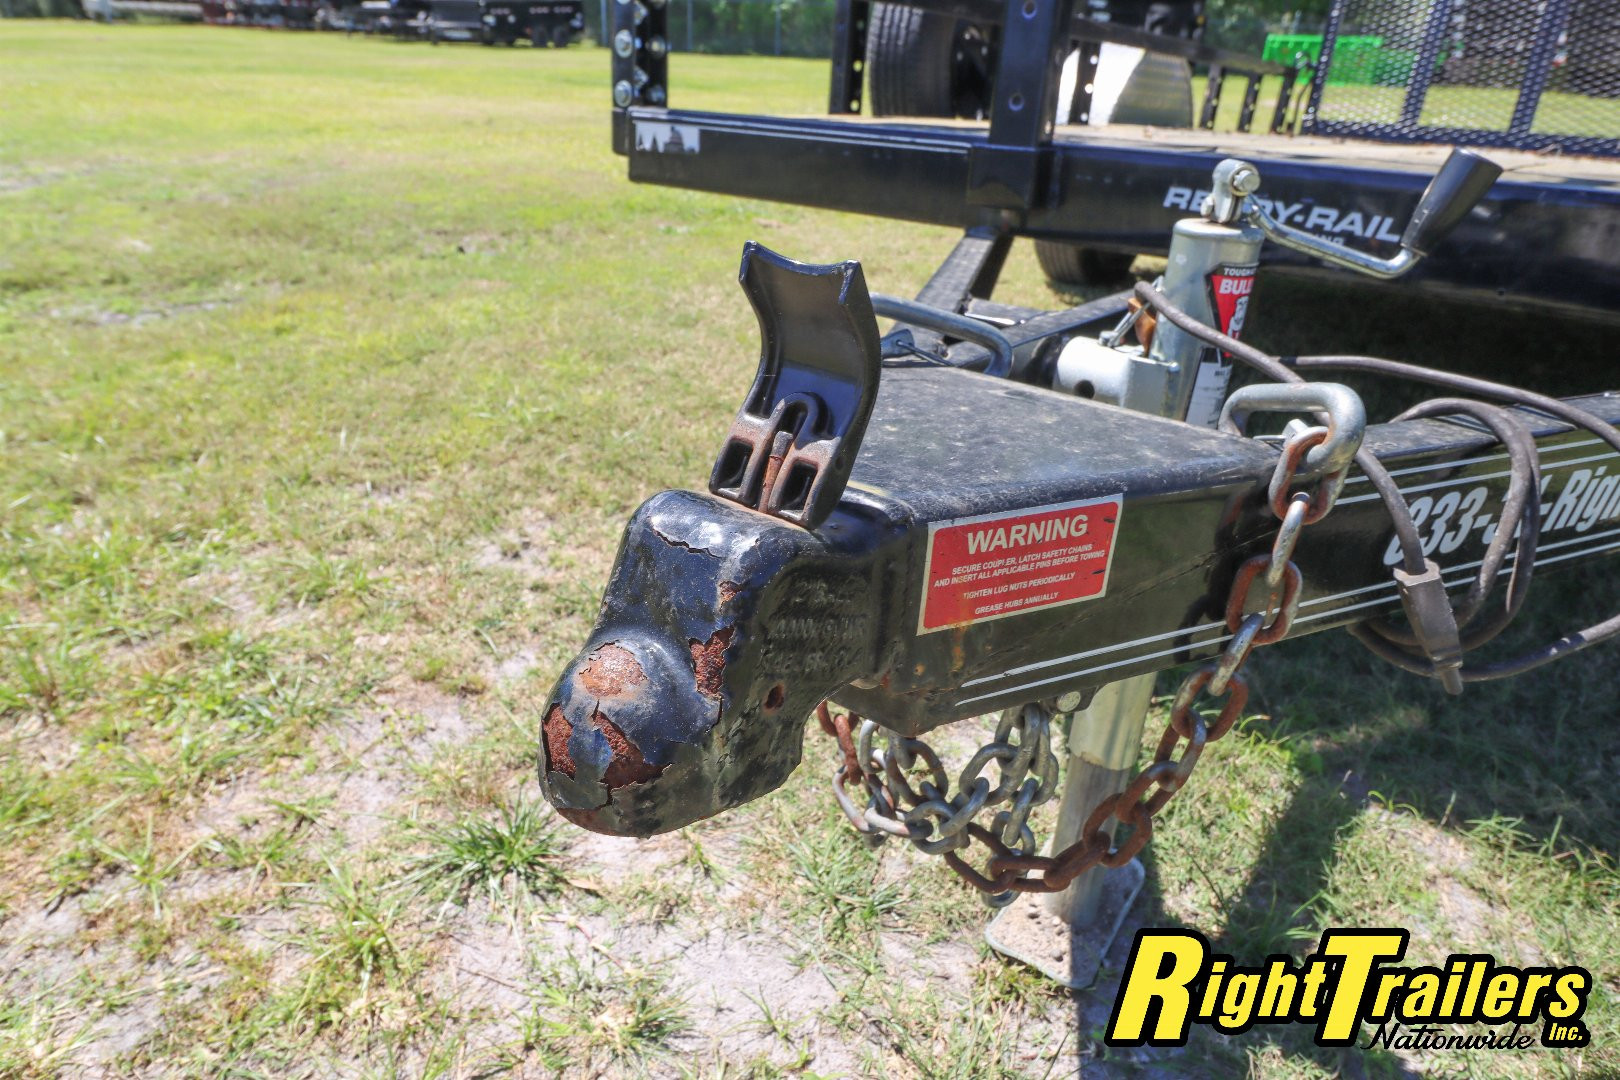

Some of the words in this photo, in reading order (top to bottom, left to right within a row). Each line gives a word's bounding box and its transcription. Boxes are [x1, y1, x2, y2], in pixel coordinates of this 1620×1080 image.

[1163, 186, 1401, 243] REDY-RAIL
[967, 514, 1089, 555] WARNING
[934, 577, 950, 588] AND
[951, 573, 977, 585] INSERT
[978, 569, 992, 580] ALL
[992, 563, 1034, 578] APPLICABLE
[1035, 559, 1051, 570] PINS
[1051, 555, 1079, 567] BEFORE
[1079, 549, 1105, 562] TOWING
[952, 561, 982, 575] SECURE
[1018, 552, 1041, 565] LATCH
[1041, 547, 1067, 560] SAFETY
[1067, 543, 1093, 555] CHAINS
[963, 587, 993, 600] TIGHTEN
[993, 584, 1008, 595] LUG
[1009, 580, 1028, 593] NUTS
[1028, 572, 1075, 588] PERIODICALLY
[975, 602, 1003, 615] GREASE
[1004, 598, 1023, 610] HUBS
[1024, 591, 1059, 606] ANNUALLY
